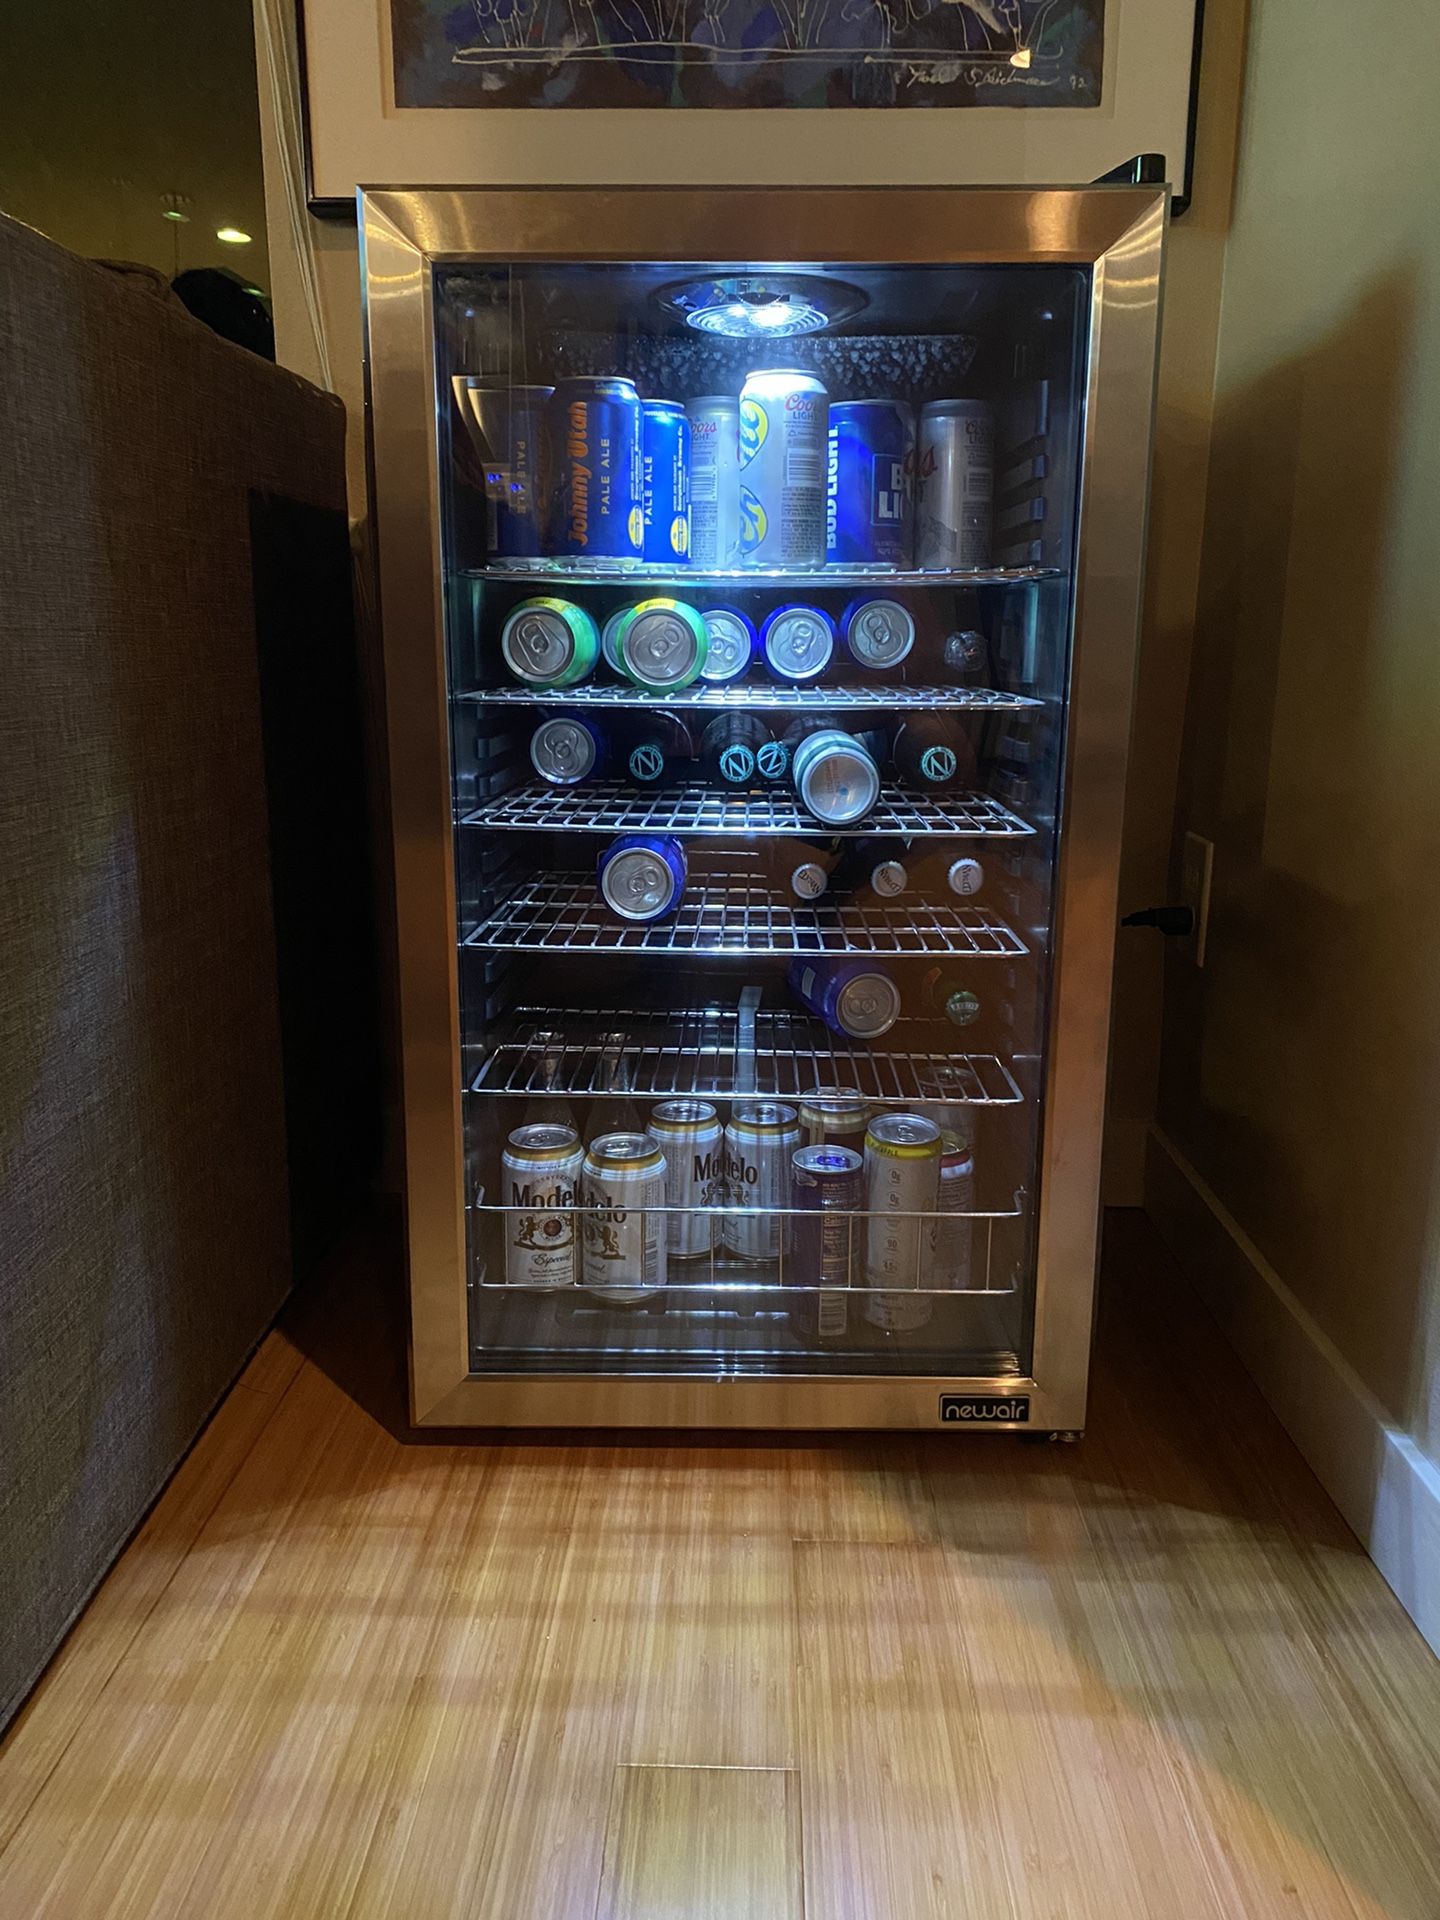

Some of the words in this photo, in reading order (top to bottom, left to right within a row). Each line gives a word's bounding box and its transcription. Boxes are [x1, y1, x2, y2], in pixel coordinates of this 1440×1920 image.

[567, 401, 588, 458] Utah
[601, 438, 610, 468] ALE
[644, 456, 653, 482] ALE
[568, 461, 593, 546] Johnny
[601, 472, 610, 515] PALE
[644, 489, 653, 525] PALE
[826, 499, 837, 549] BUD
[945, 1400, 1025, 1419] newair
